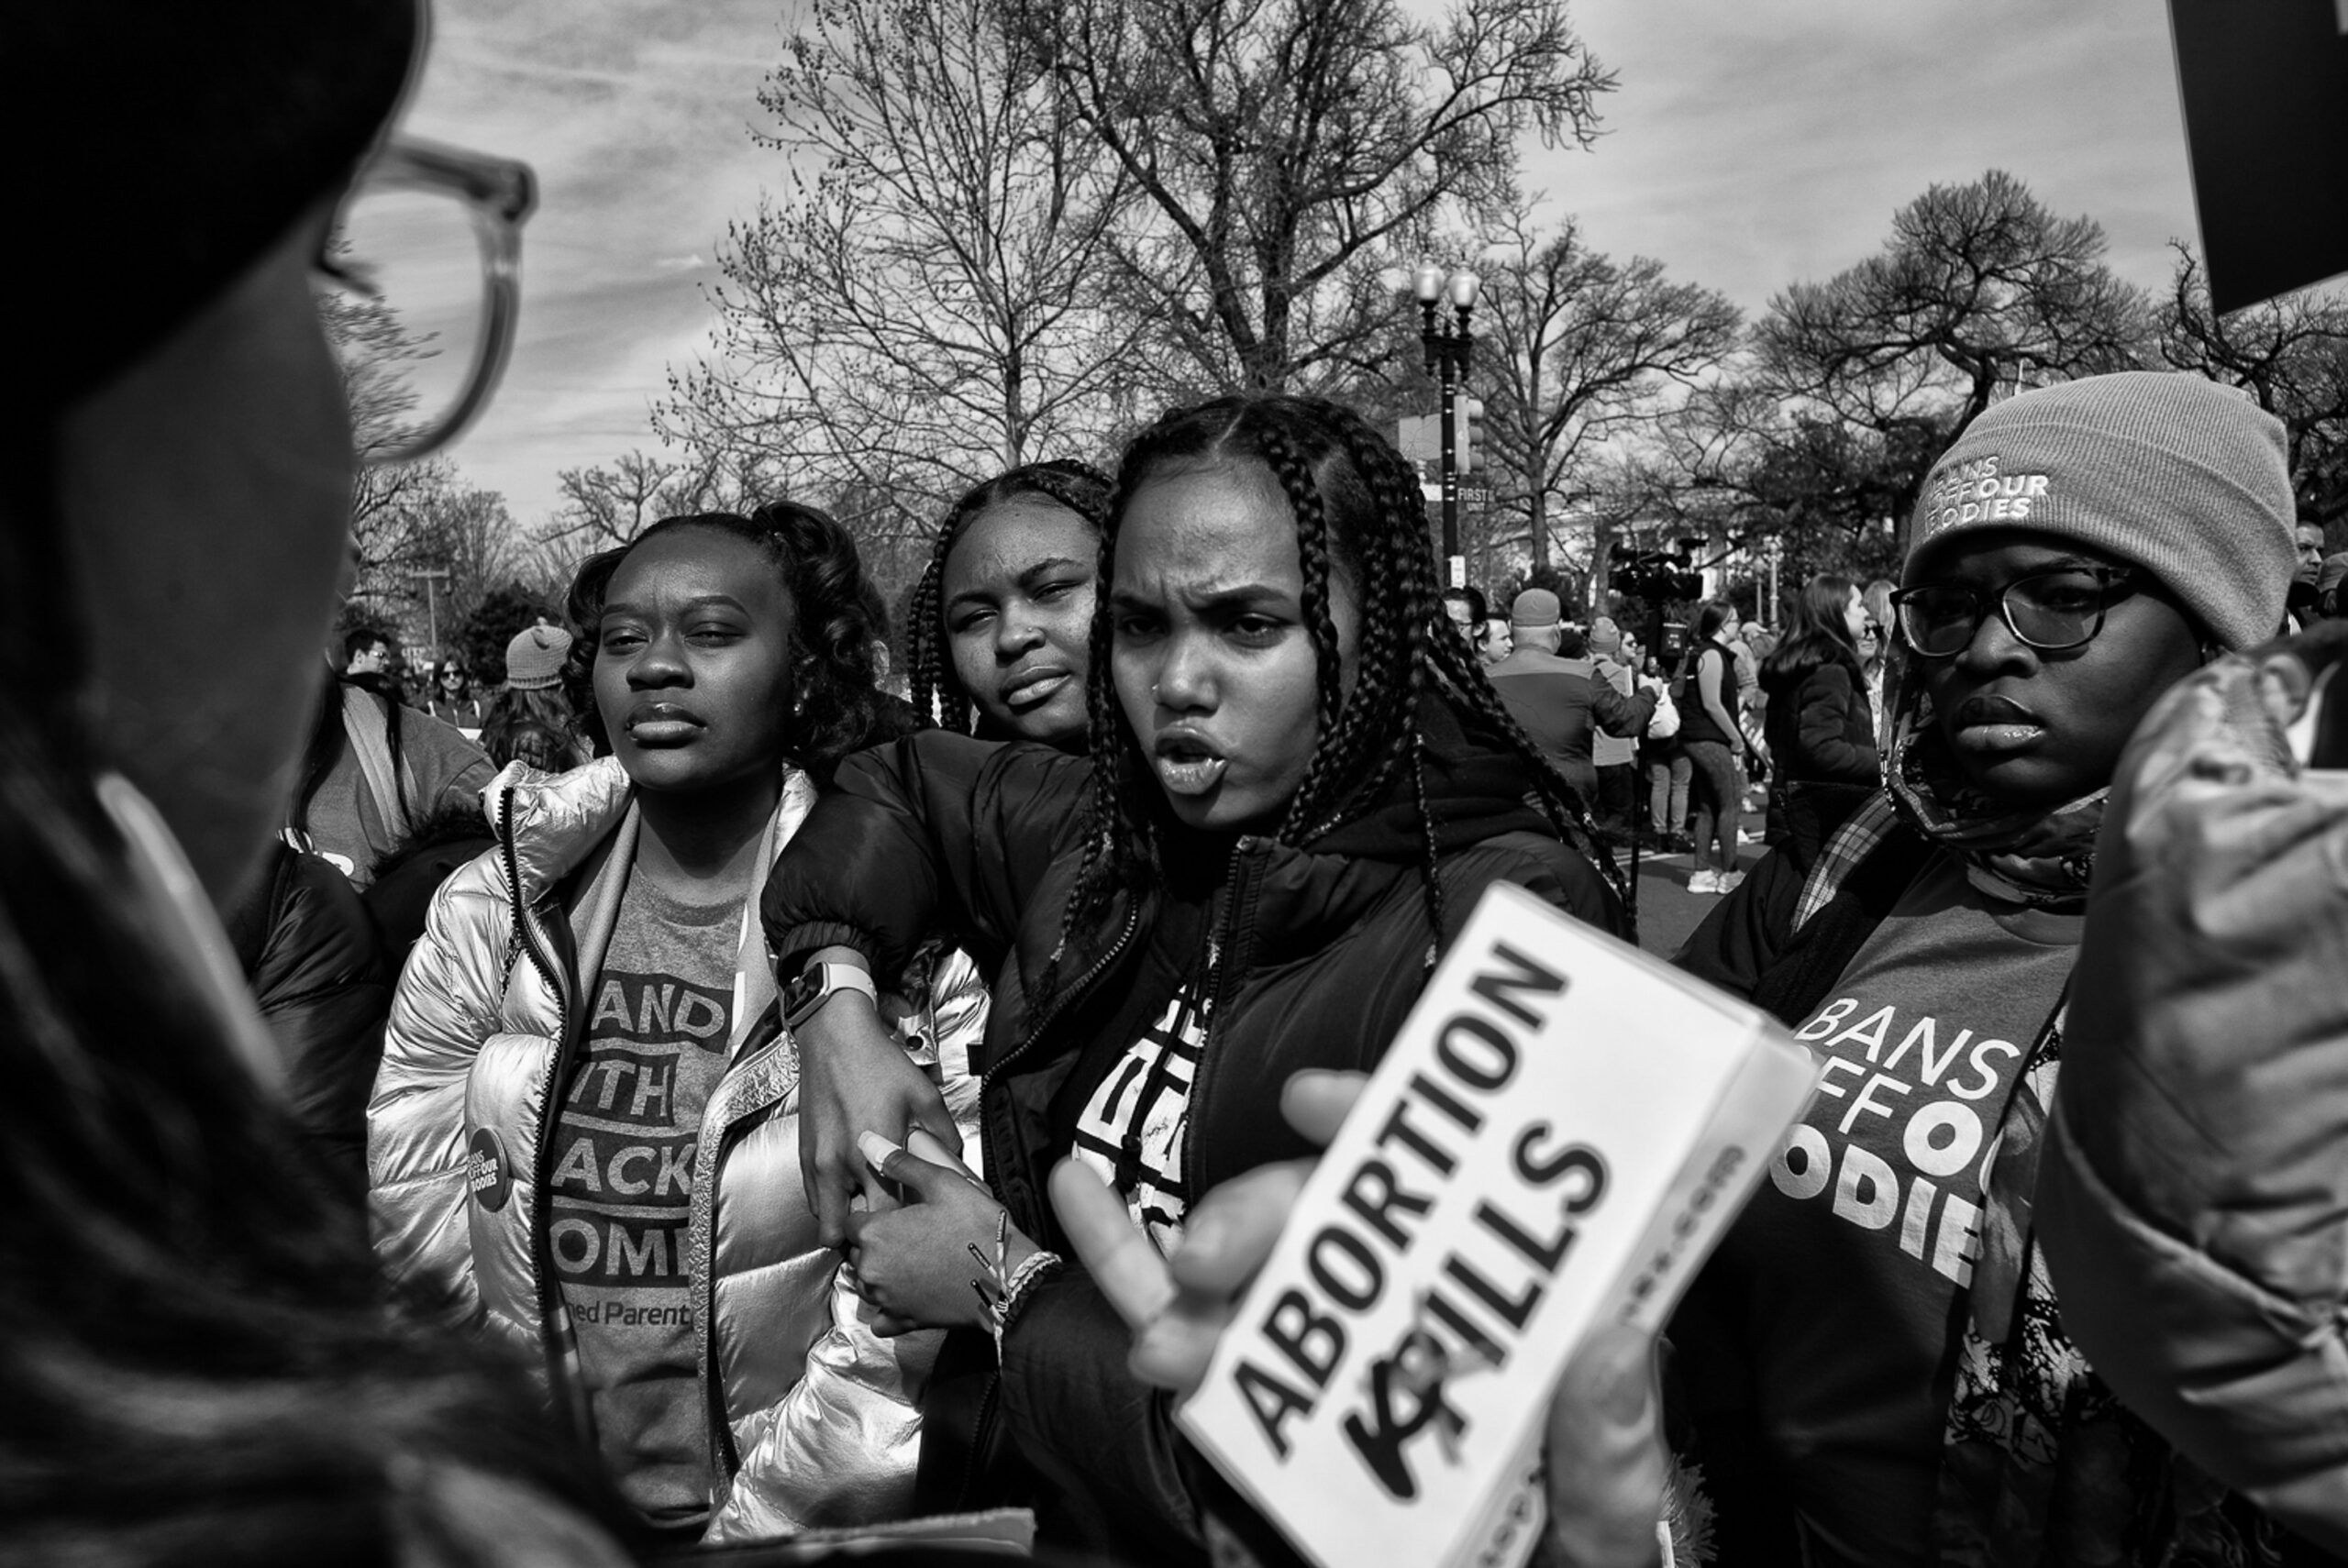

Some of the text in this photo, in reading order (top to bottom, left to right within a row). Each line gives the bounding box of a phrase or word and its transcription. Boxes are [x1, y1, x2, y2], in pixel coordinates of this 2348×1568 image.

[1978, 474, 2049, 499] OUR
[591, 979, 725, 1038] AND
[1794, 997, 2021, 1100] BANS
[569, 1059, 670, 1118] ITH
[550, 1137, 697, 1197] ACK
[1231, 940, 1572, 1463] ABORTION
[1769, 1123, 1984, 1289] ODIE
[549, 1218, 690, 1276] OM
